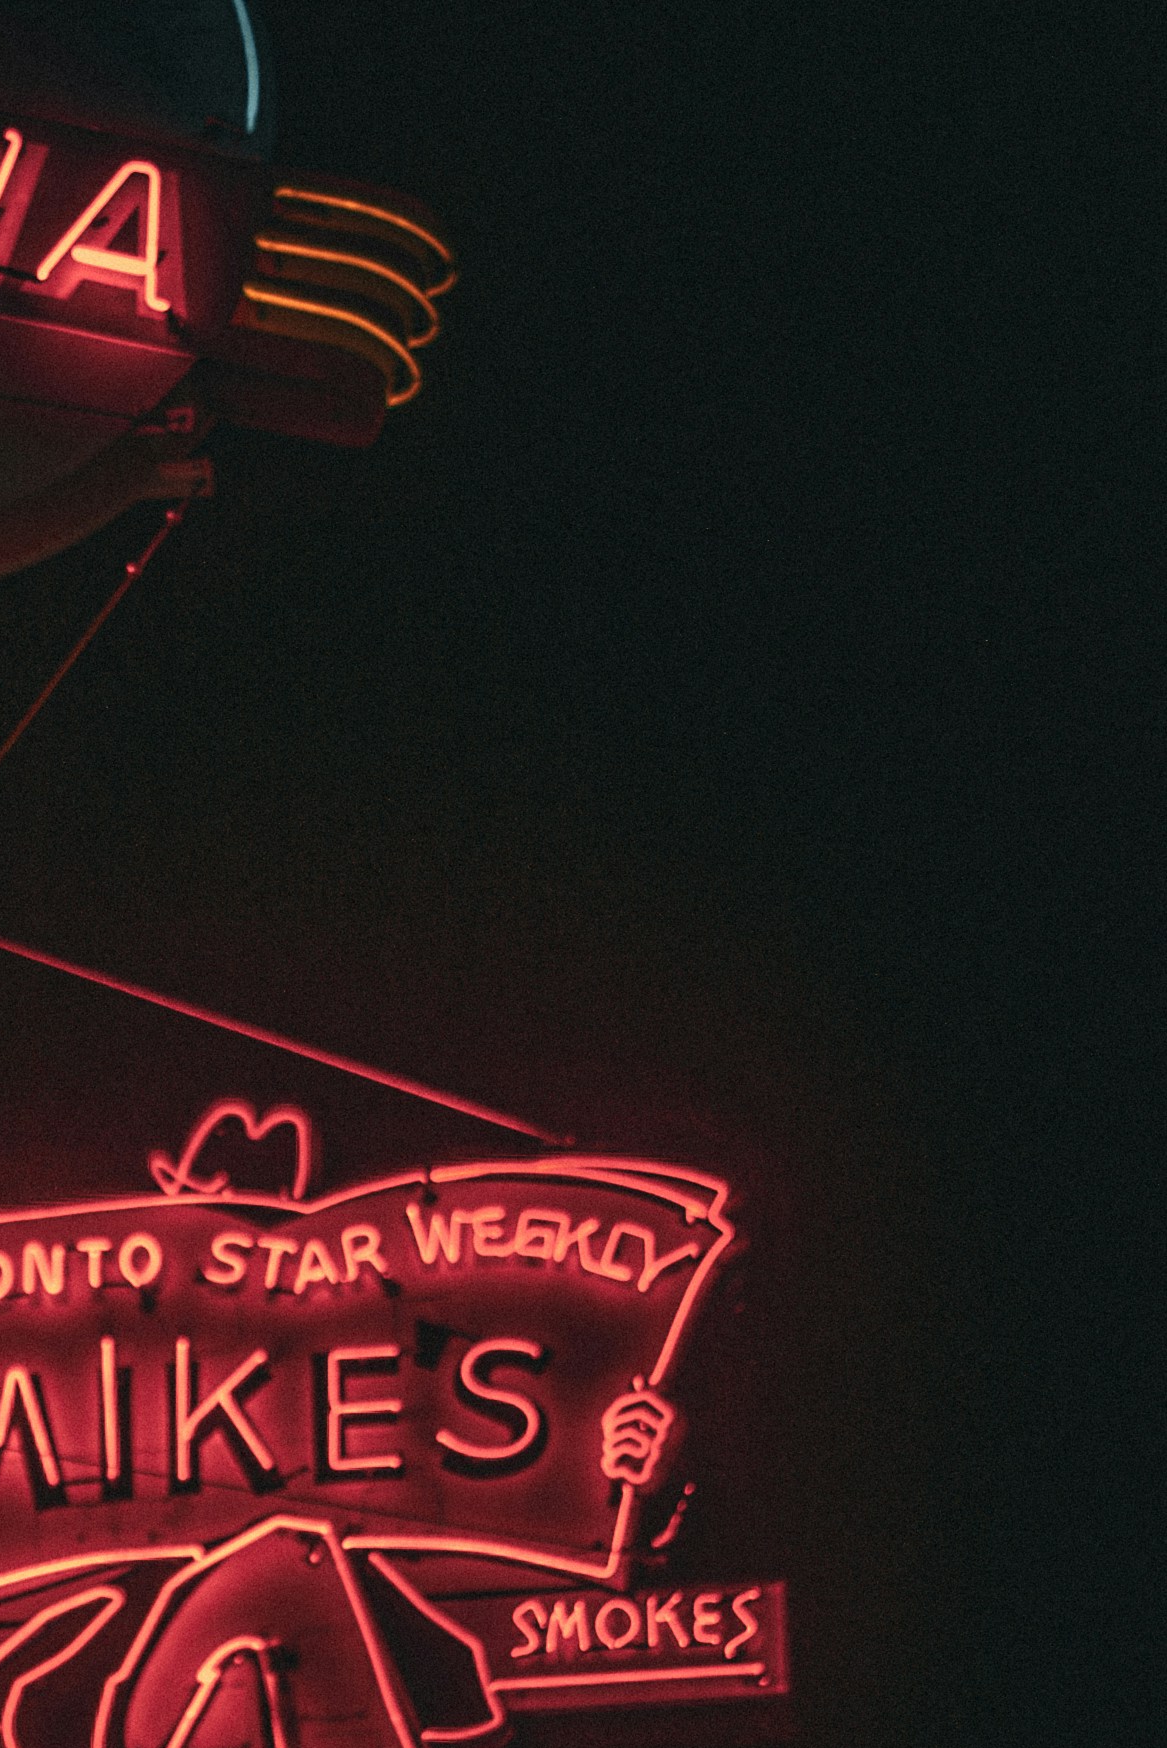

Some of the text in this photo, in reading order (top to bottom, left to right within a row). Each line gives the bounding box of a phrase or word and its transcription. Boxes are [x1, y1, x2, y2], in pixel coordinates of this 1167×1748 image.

[202, 1223, 390, 1296] STAR
[405, 1203, 700, 1293] WEEKLY
[509, 1588, 763, 1661] SMOKES
